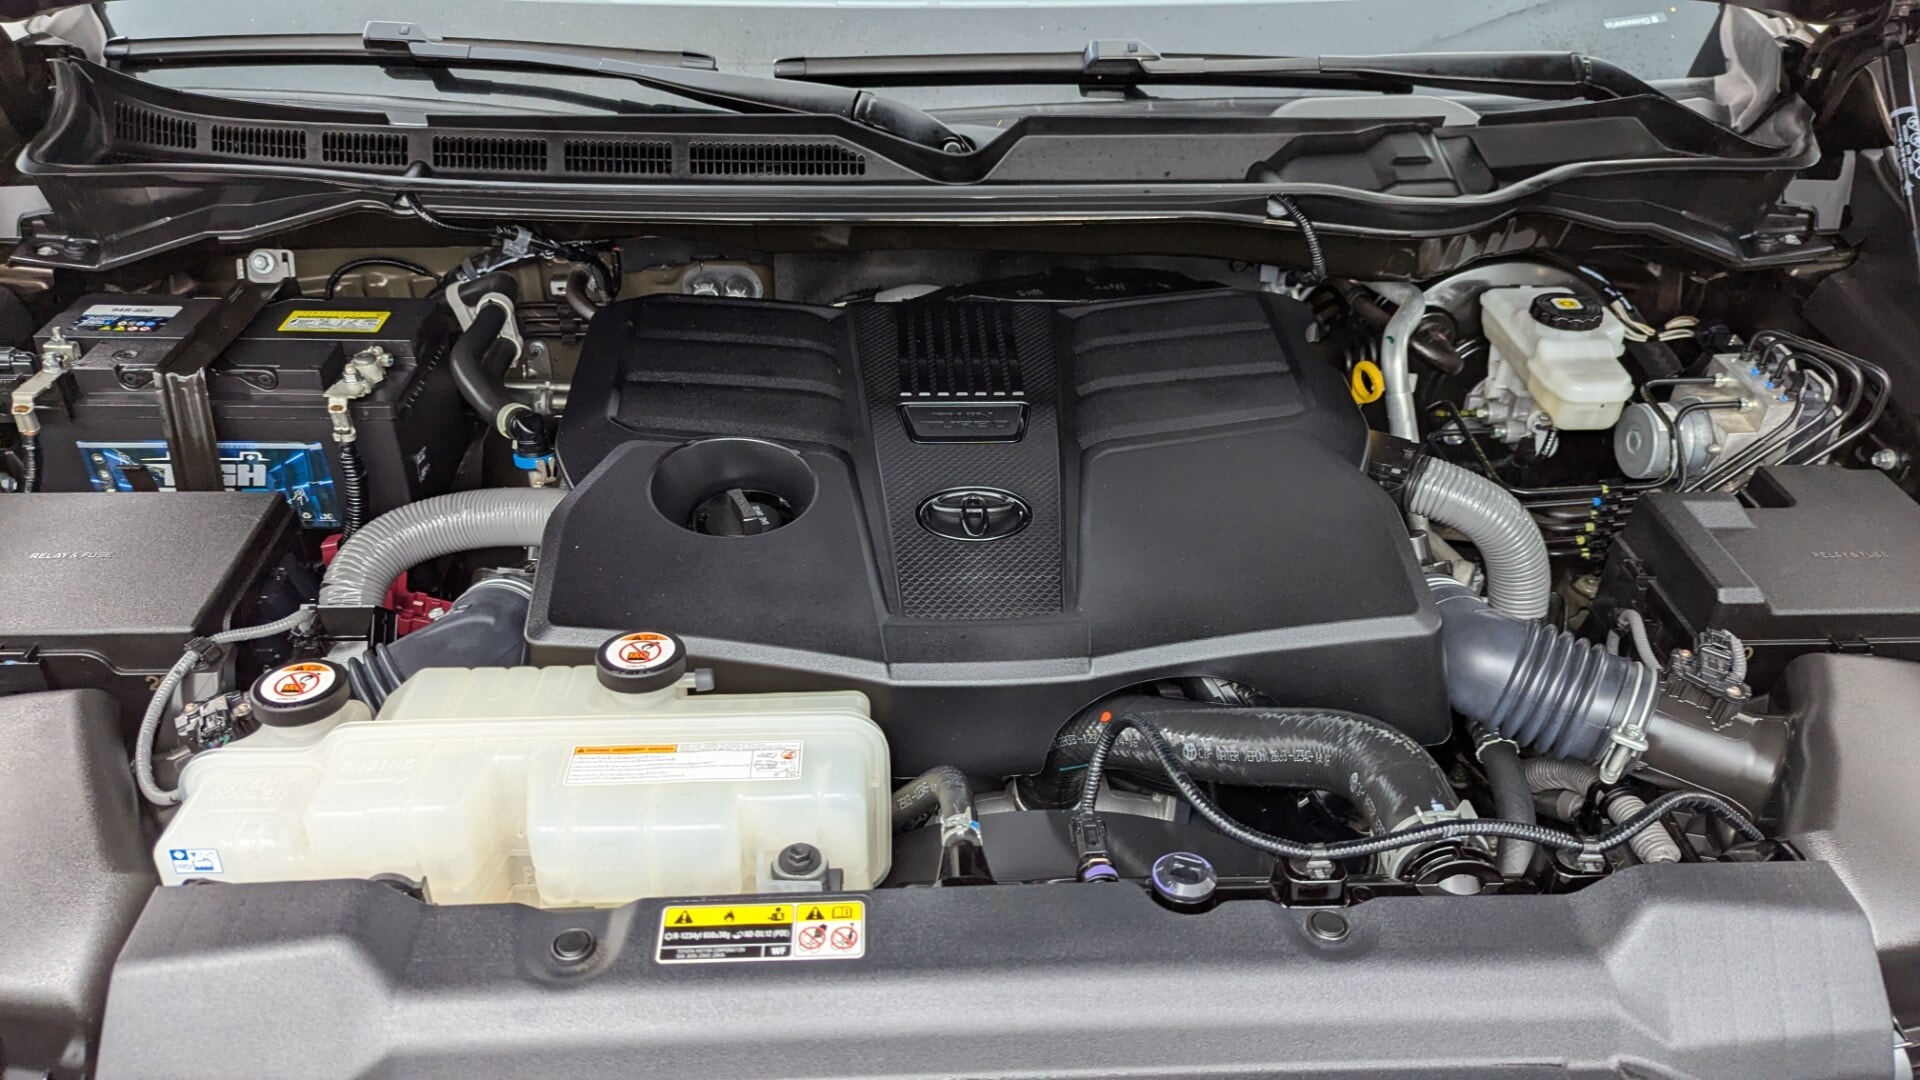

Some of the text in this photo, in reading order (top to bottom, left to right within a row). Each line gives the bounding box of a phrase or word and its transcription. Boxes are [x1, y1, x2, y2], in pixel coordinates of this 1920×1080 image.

[920, 420, 1010, 429] TURBO
[81, 551, 114, 559] FUSE
[340, 758, 416, 773] ENGINE
[770, 947, 787, 955] WF
